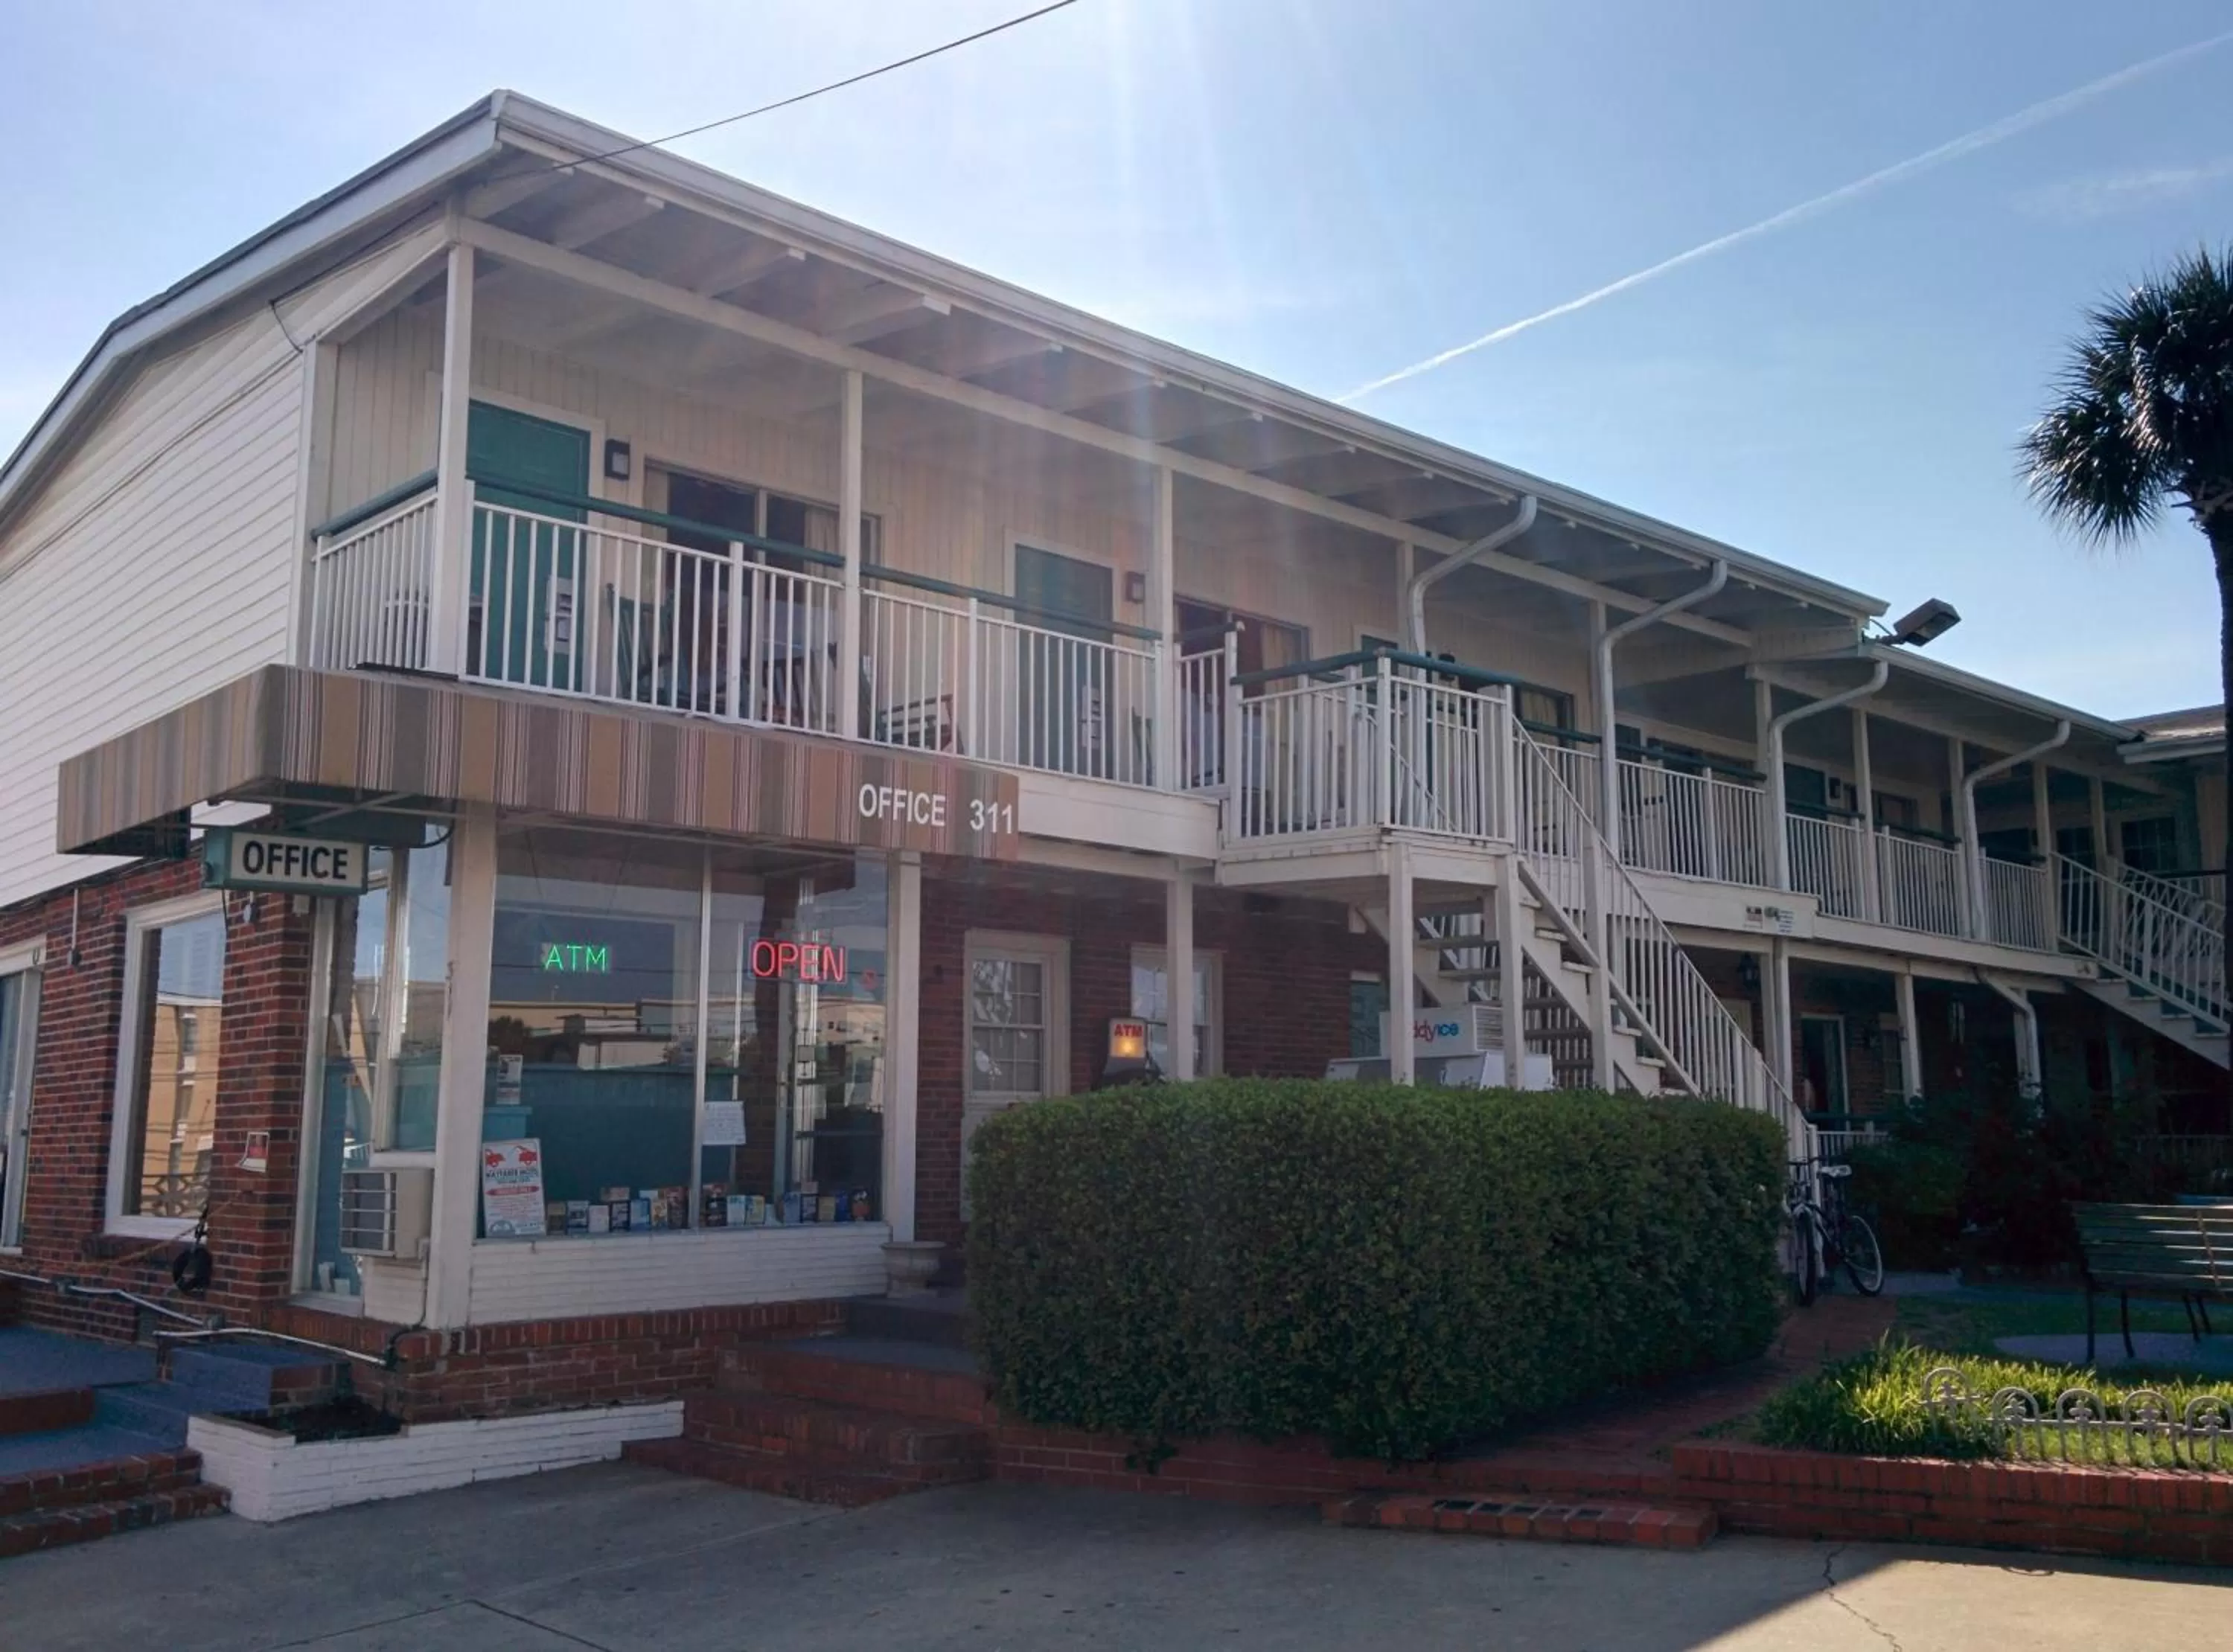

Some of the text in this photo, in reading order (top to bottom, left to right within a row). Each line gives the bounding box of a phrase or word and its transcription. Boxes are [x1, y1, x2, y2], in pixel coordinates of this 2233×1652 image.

[858, 784, 1013, 834] OFFICE 311
[243, 840, 348, 880] OFFICE
[545, 944, 606, 973] ATM
[752, 941, 844, 982] OPEN
[1114, 1023, 1144, 1037] ATM
